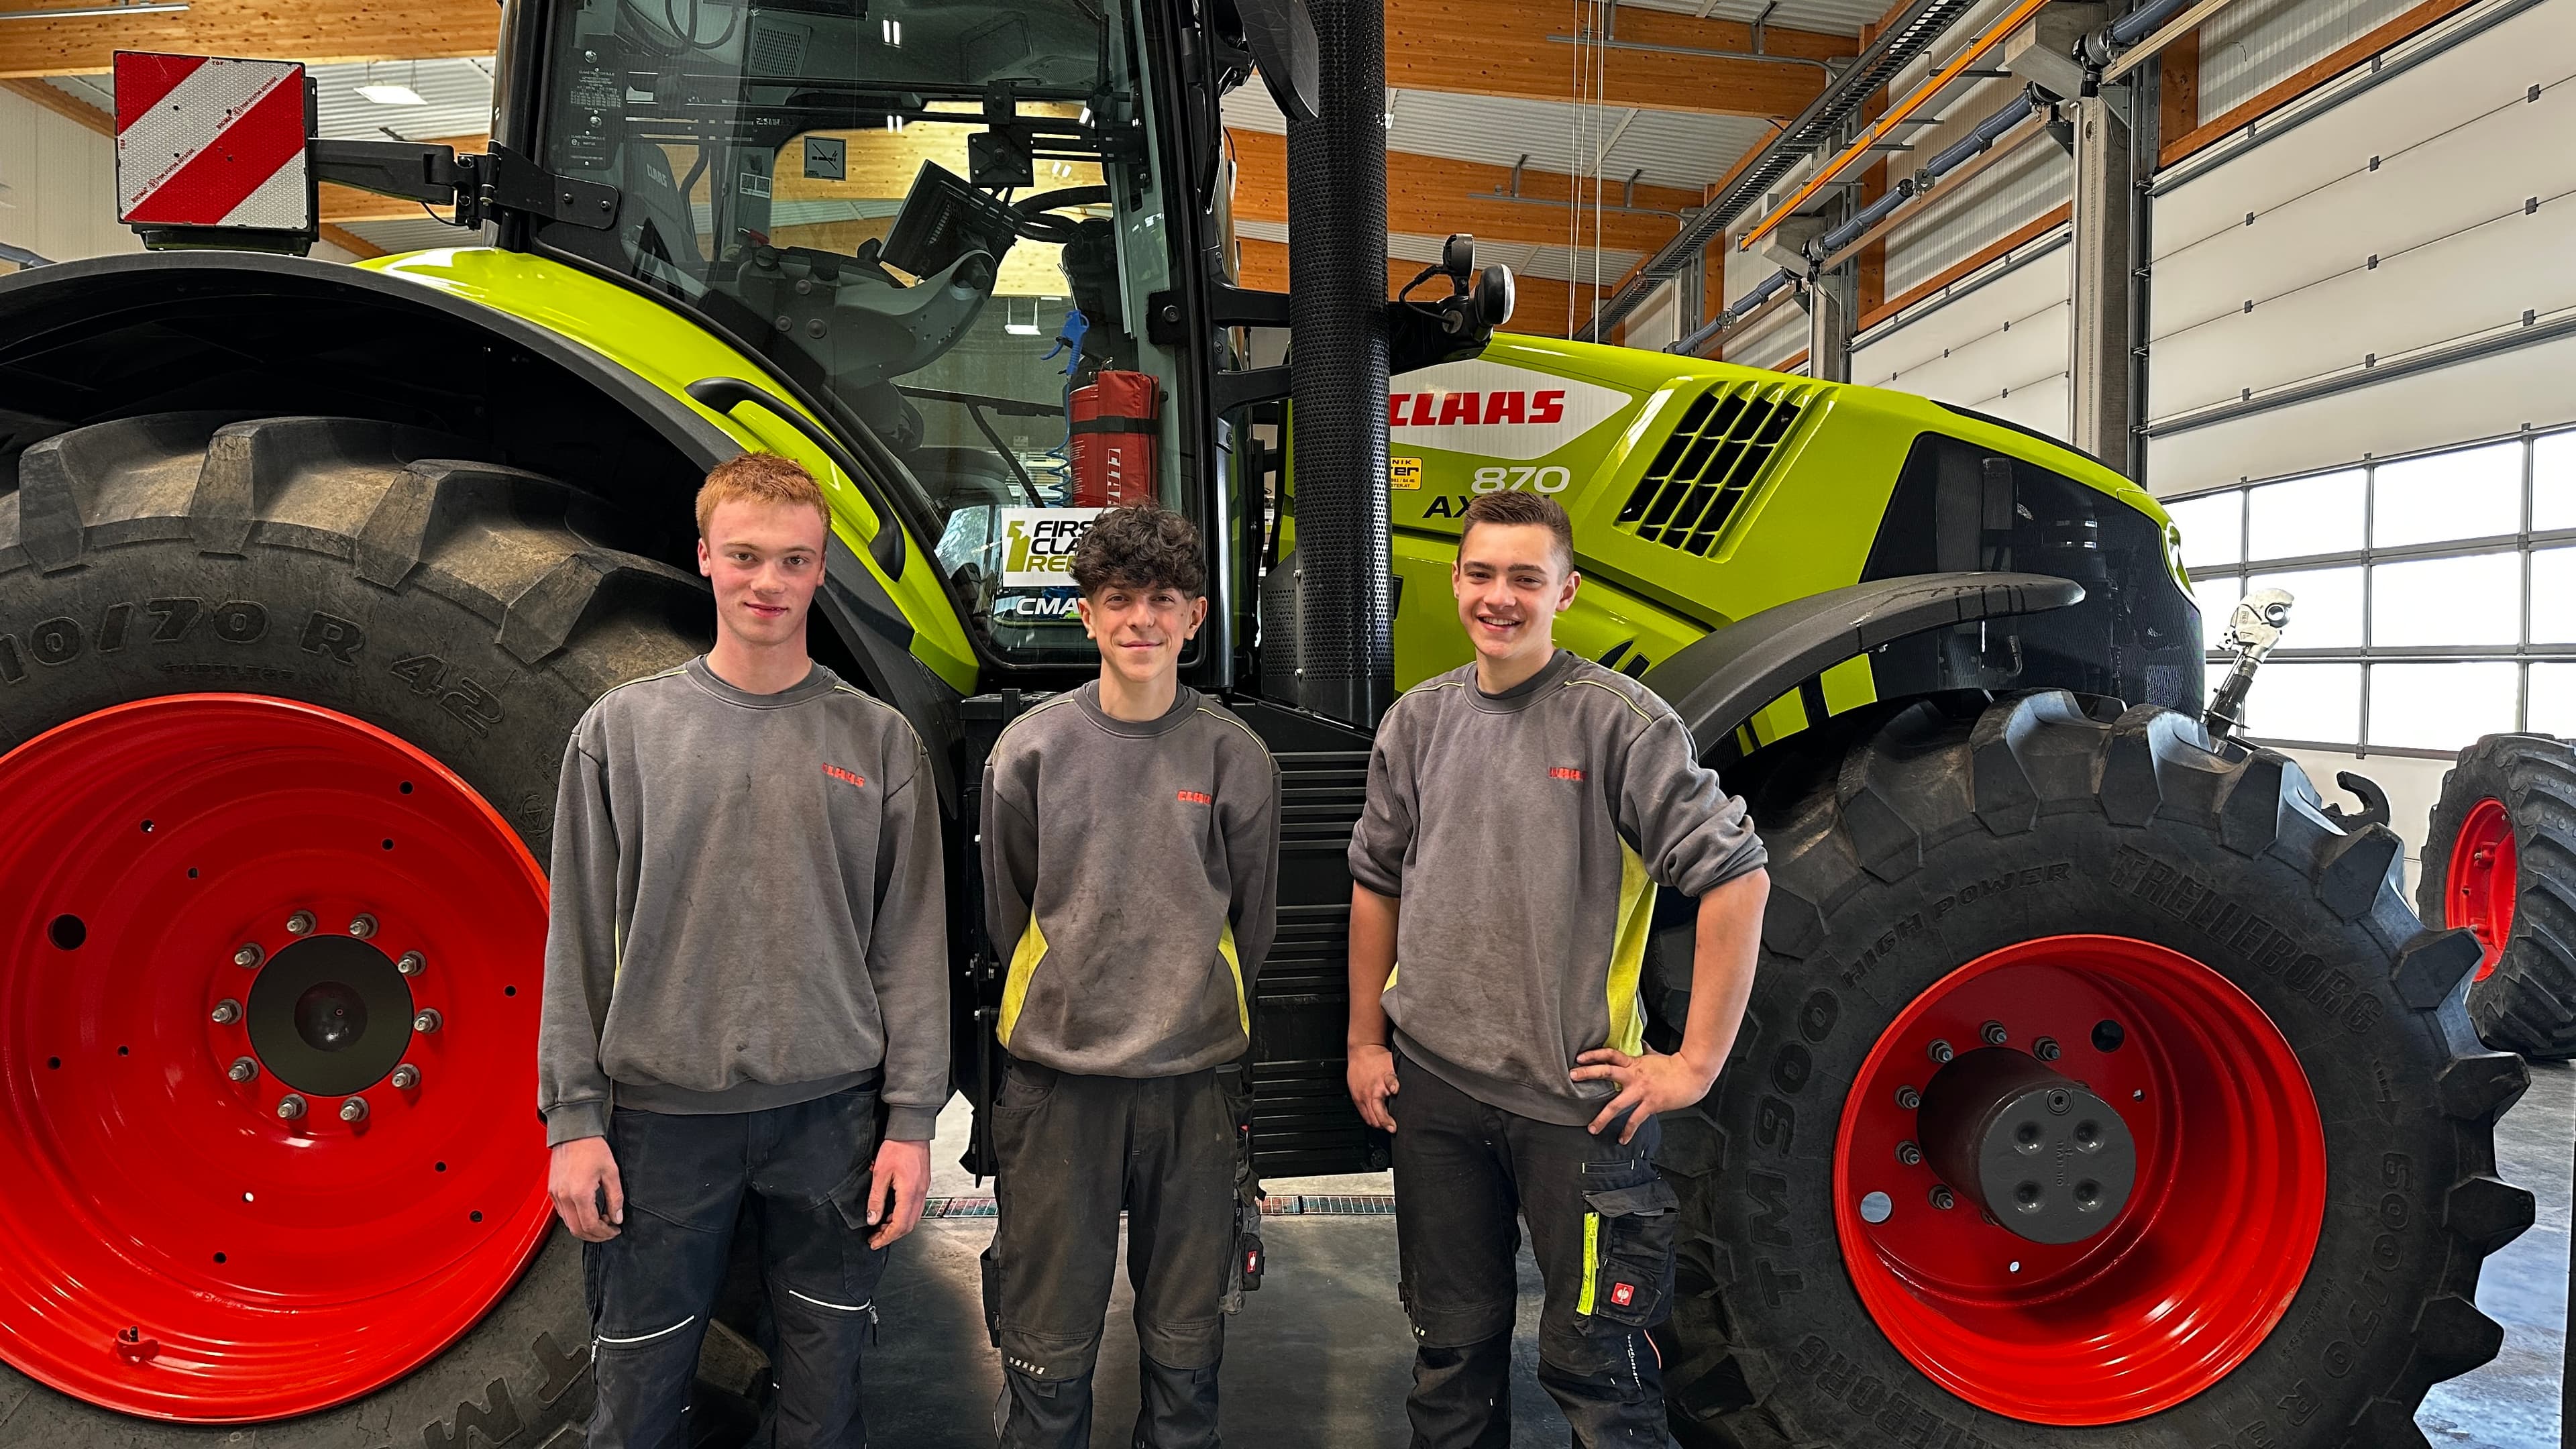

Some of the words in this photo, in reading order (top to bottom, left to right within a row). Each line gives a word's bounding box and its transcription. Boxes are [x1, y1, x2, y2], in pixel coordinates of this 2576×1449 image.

[1389, 390, 1566, 427] CLAAS
[1108, 449, 1120, 505] CLAA
[1391, 467, 1419, 476] er
[1470, 466, 1570, 494] 870
[1034, 521, 1095, 537] FIRS
[1030, 538, 1079, 555] CLA
[301, 610, 366, 666] R
[390, 654, 505, 739] 42
[1177, 790, 1212, 805] CLAA
[1841, 912, 1924, 991] HIGH
[1933, 863, 2072, 922] POWER
[2108, 843, 2384, 1033] TRELLEBORG
